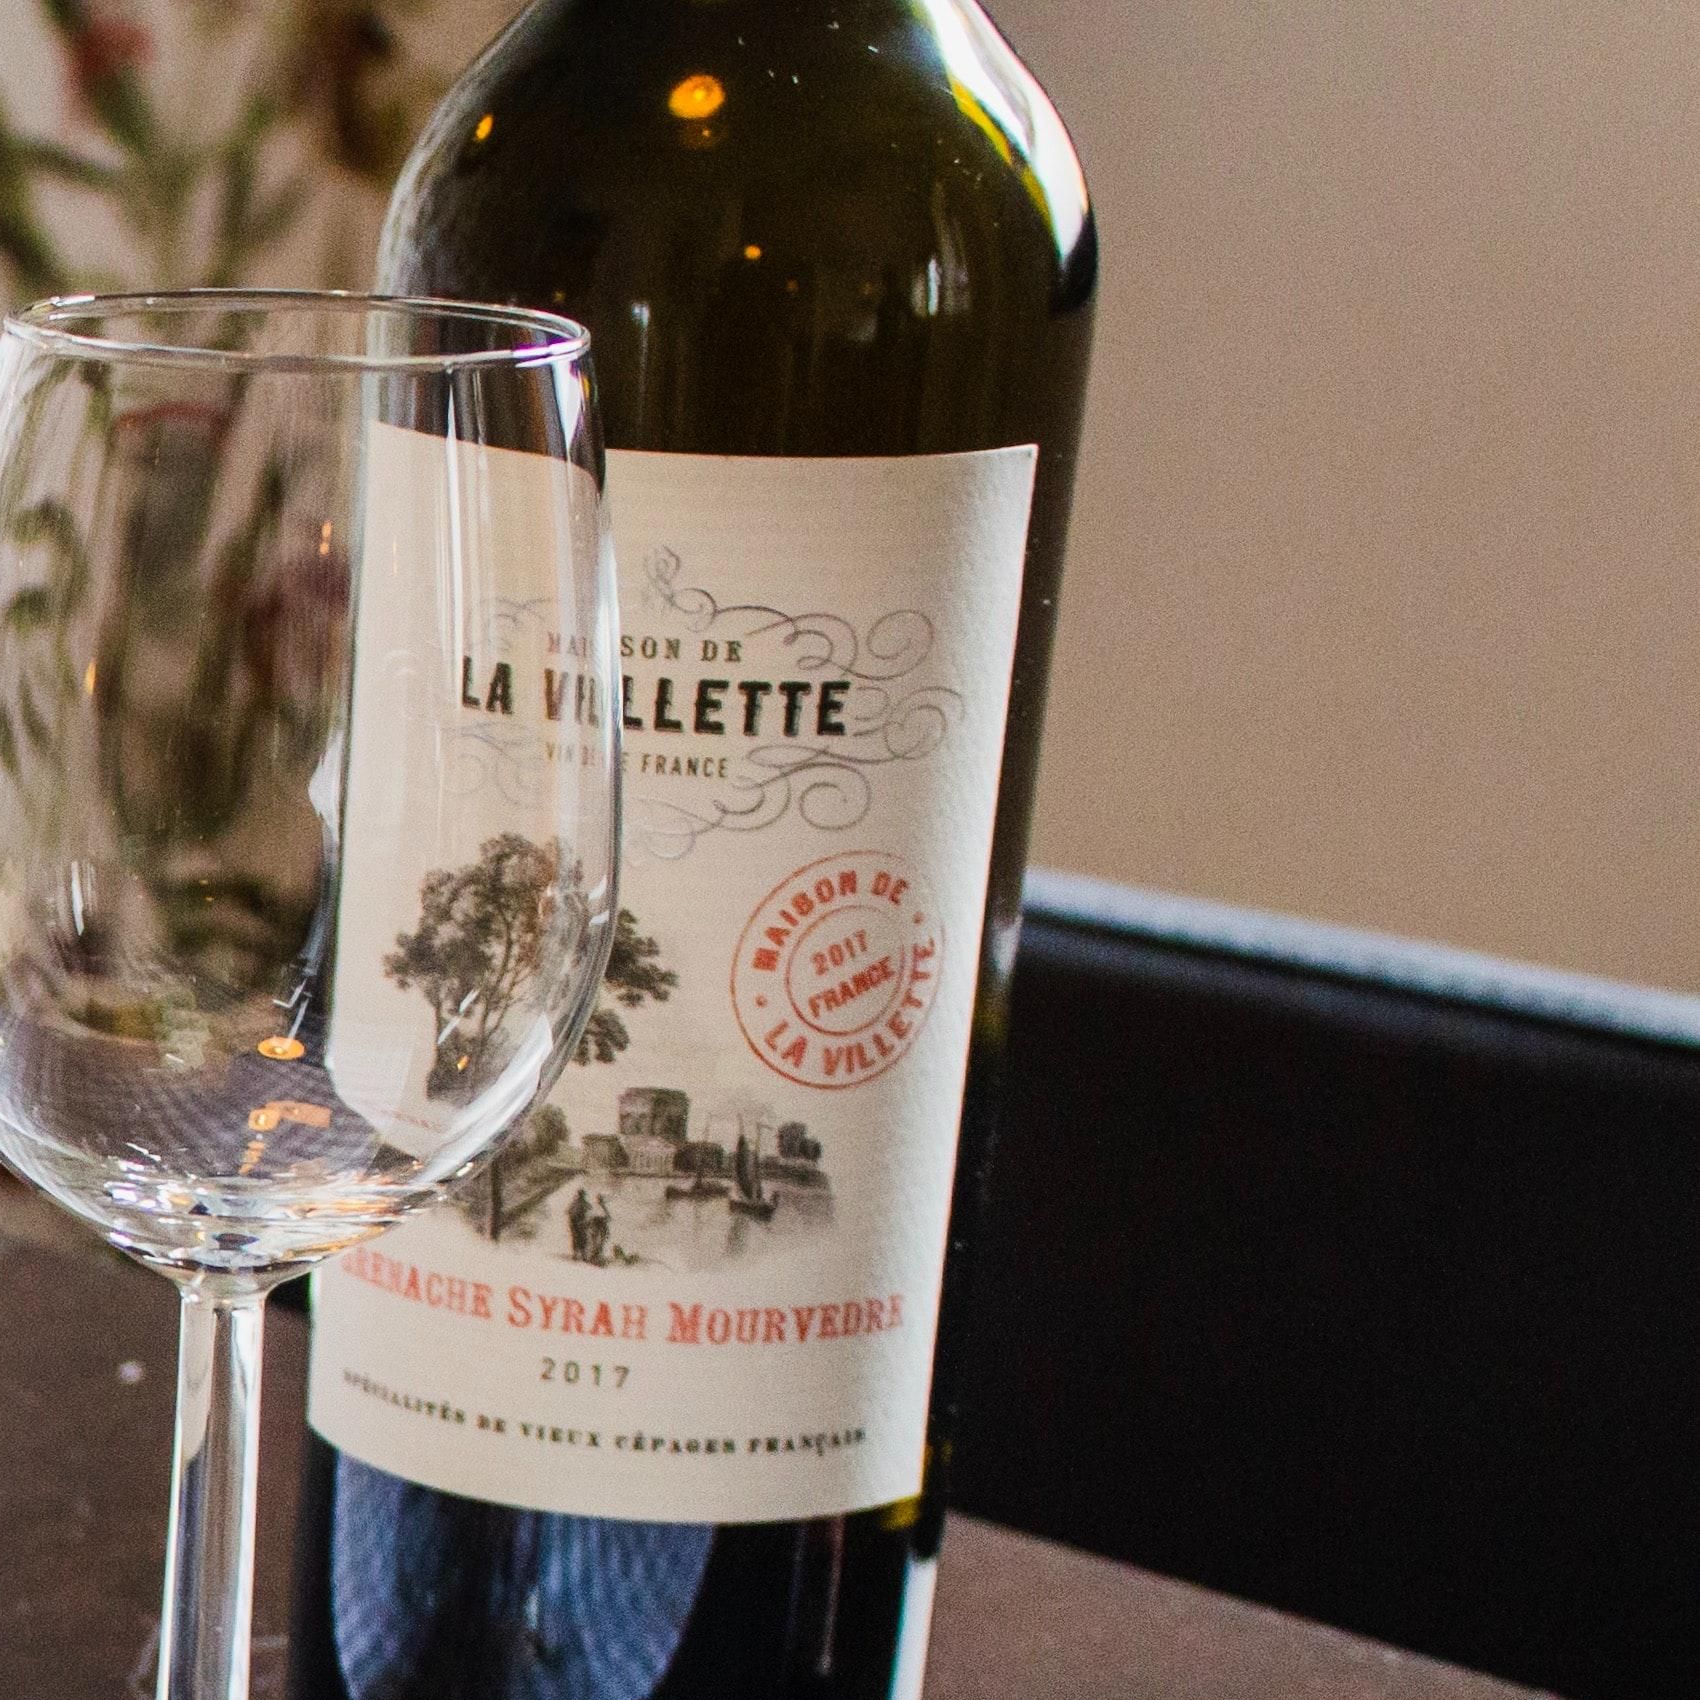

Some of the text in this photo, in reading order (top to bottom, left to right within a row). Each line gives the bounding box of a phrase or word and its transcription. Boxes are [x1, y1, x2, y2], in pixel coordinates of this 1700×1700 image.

[547, 631, 743, 663] MAISON DE
[461, 655, 851, 738] LA VILLETTE
[640, 754, 728, 779] FRANCE
[752, 870, 910, 973] MAISON DE
[811, 929, 868, 976] 2017
[764, 936, 936, 1077] LA VILLETTE
[808, 955, 896, 1019] FRANCE
[506, 1284, 648, 1341] SYRAH
[540, 1356, 630, 1388] 2017
[476, 1413, 507, 1434] DE
[520, 1421, 600, 1448] VIEUX
